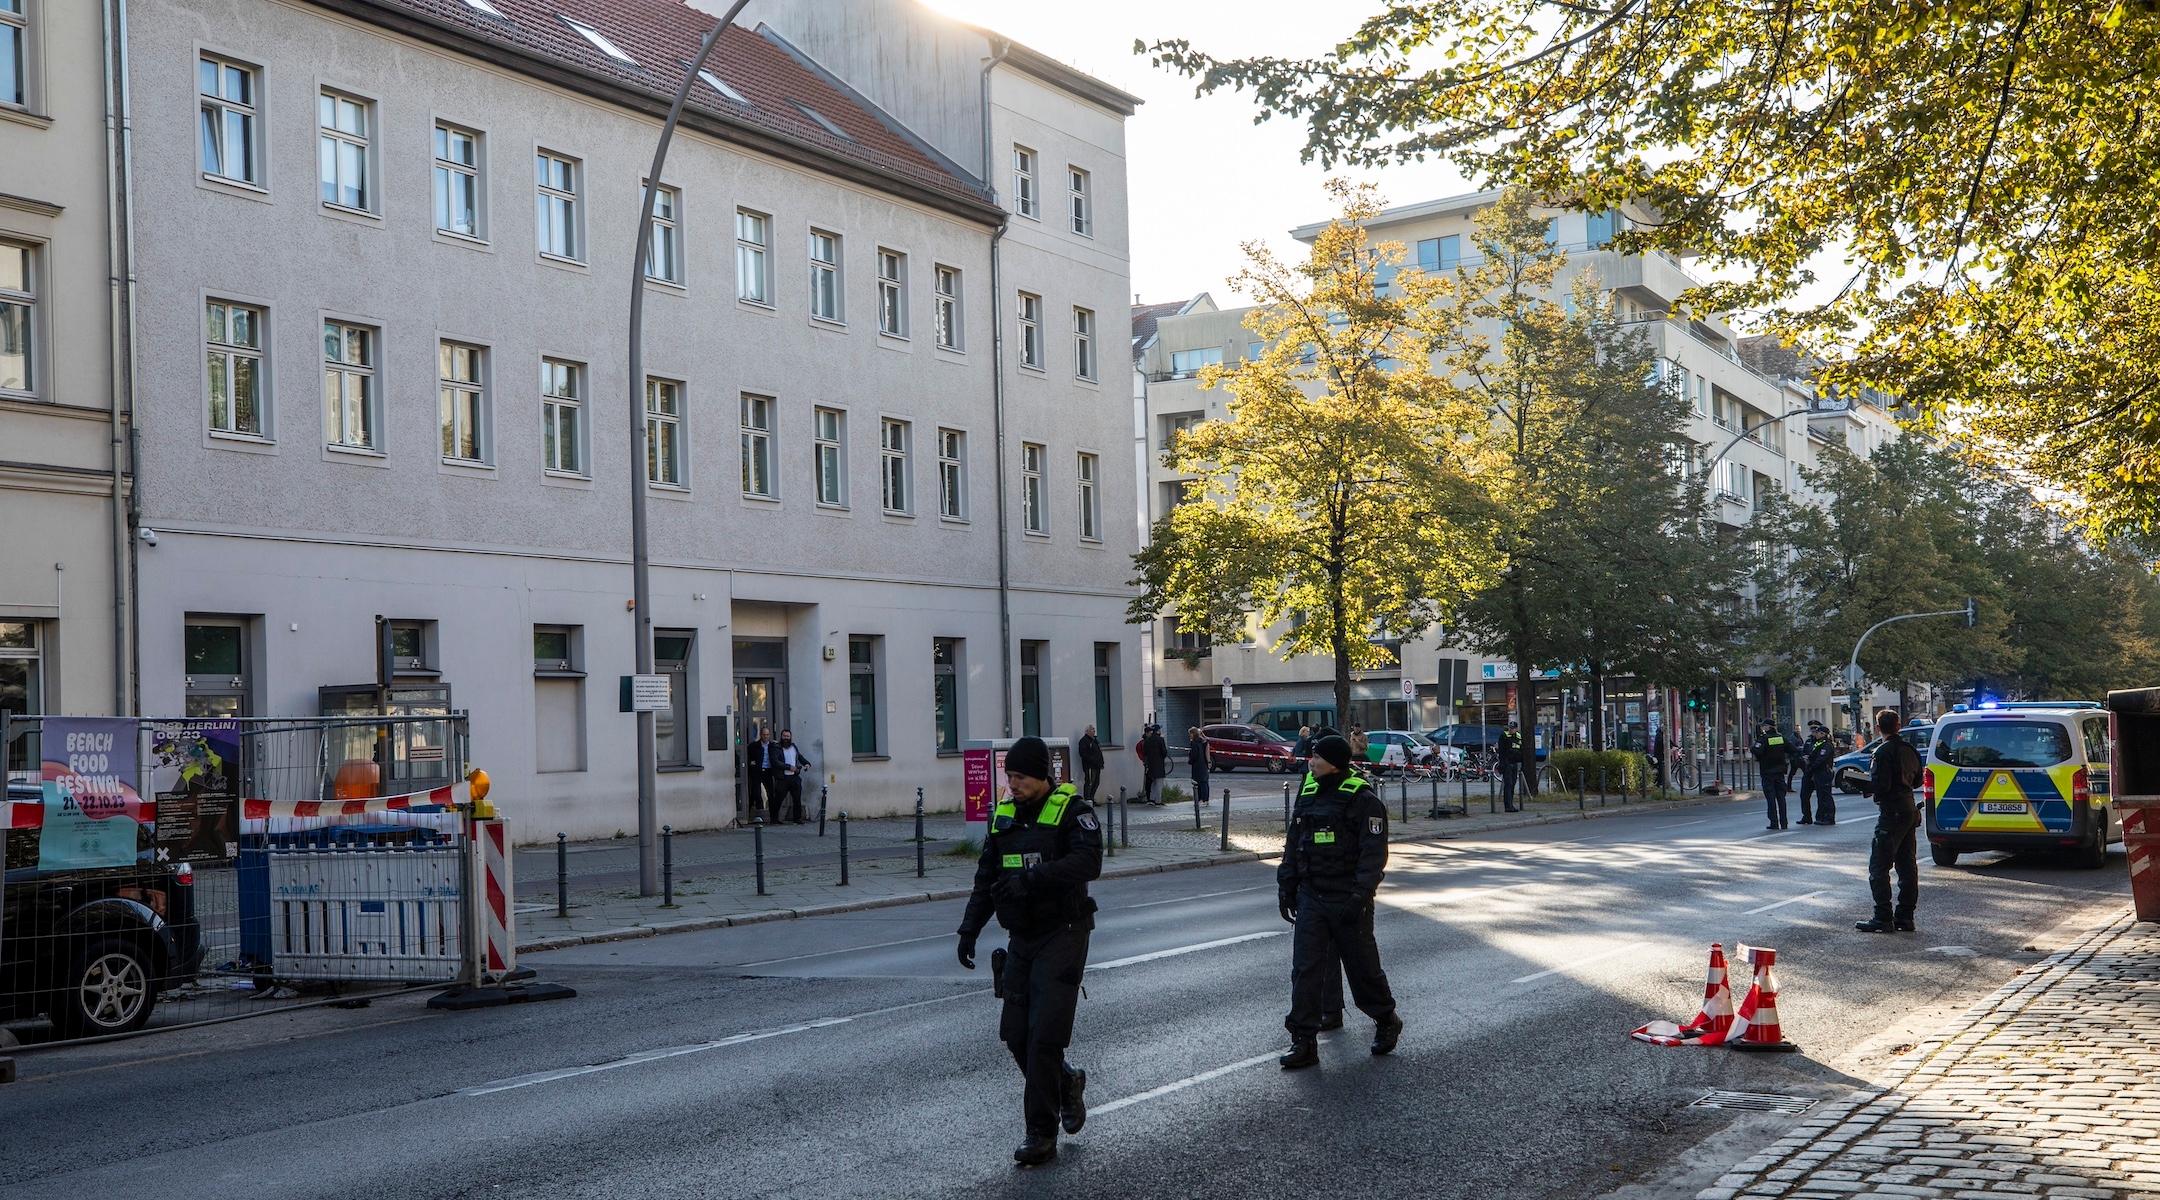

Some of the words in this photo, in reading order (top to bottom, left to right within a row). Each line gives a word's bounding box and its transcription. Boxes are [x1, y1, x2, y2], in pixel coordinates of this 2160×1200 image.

[1496, 664, 1518, 672] KOSH
[66, 732, 114, 752] BEACH
[69, 753, 109, 773] FOOD
[55, 774, 124, 795] FESTIVAL
[63, 795, 125, 811] 21.-22.10.23
[1987, 803, 1994, 811] B
[1997, 803, 2023, 811] 30858
